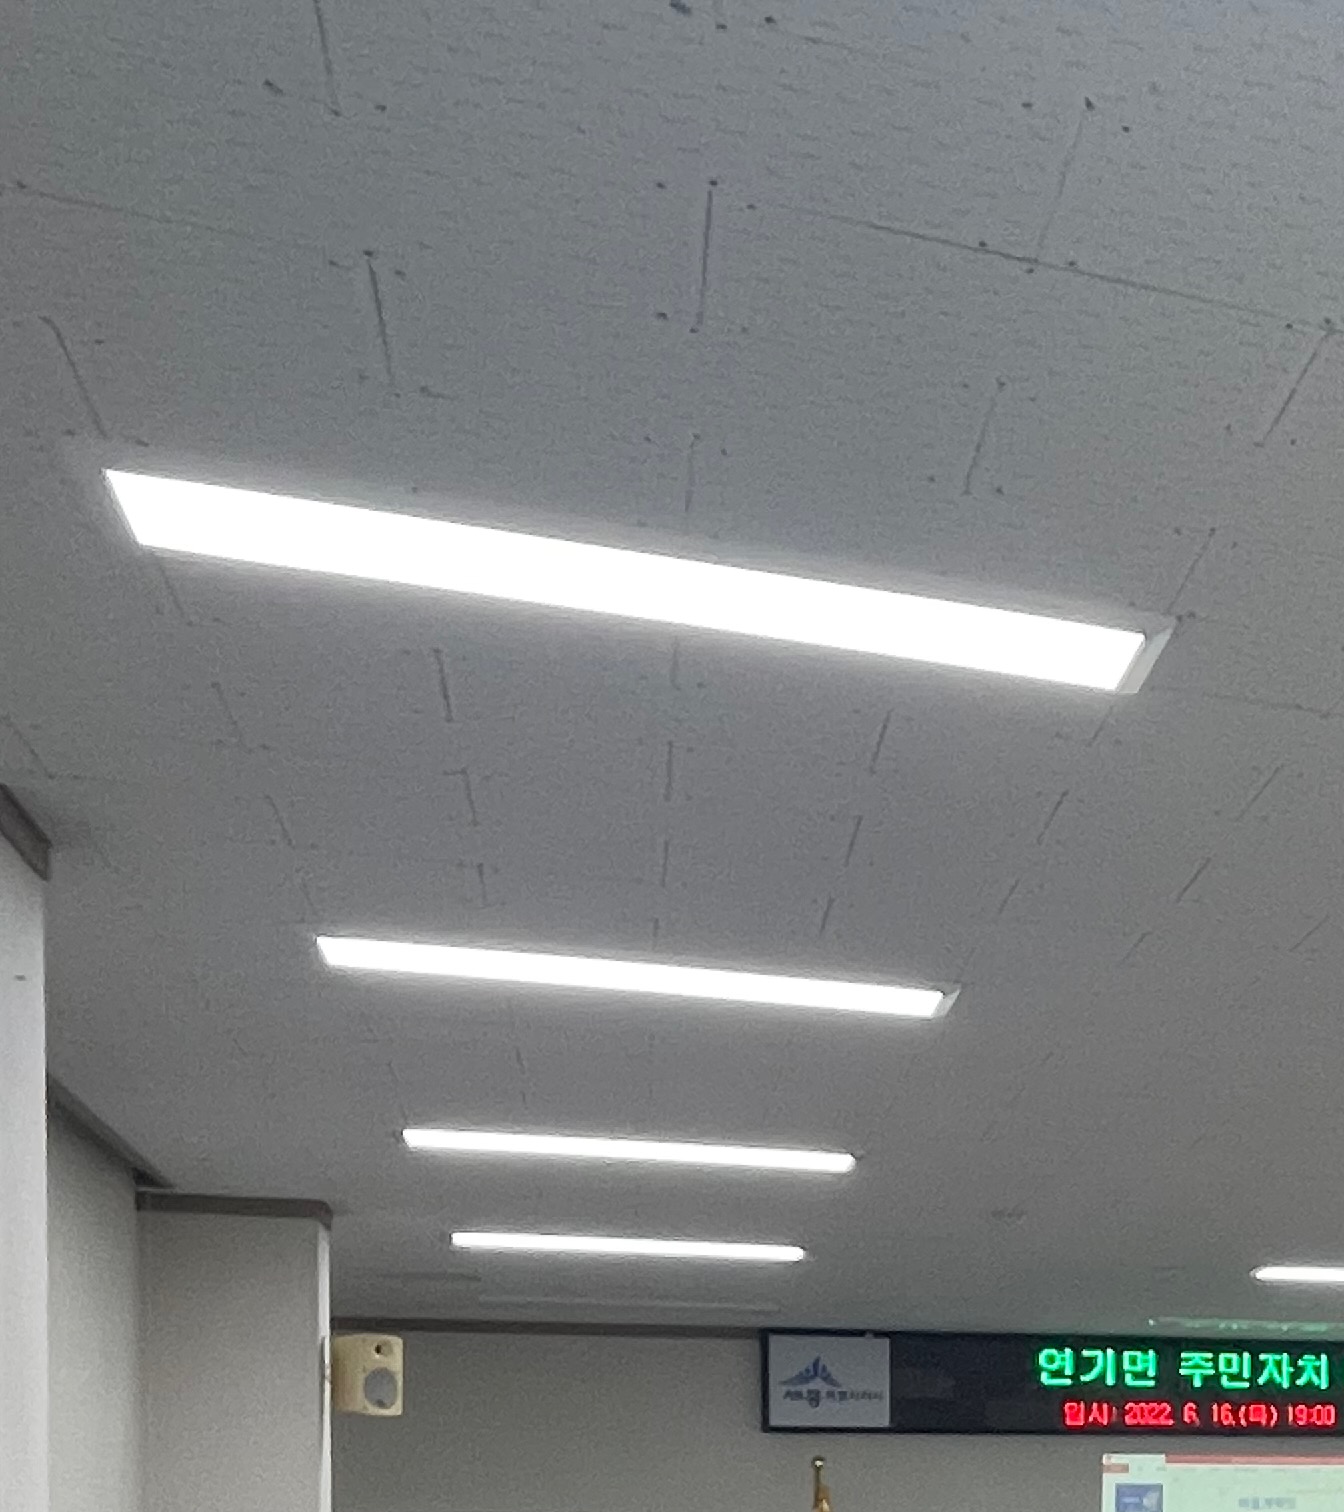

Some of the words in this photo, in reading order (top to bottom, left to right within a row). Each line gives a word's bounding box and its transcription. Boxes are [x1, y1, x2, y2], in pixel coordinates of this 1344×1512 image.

[1037, 1347, 1158, 1387] 연기면
[1178, 1351, 1330, 1390] 주민자치
[1287, 1403, 1336, 1426] 19:00
